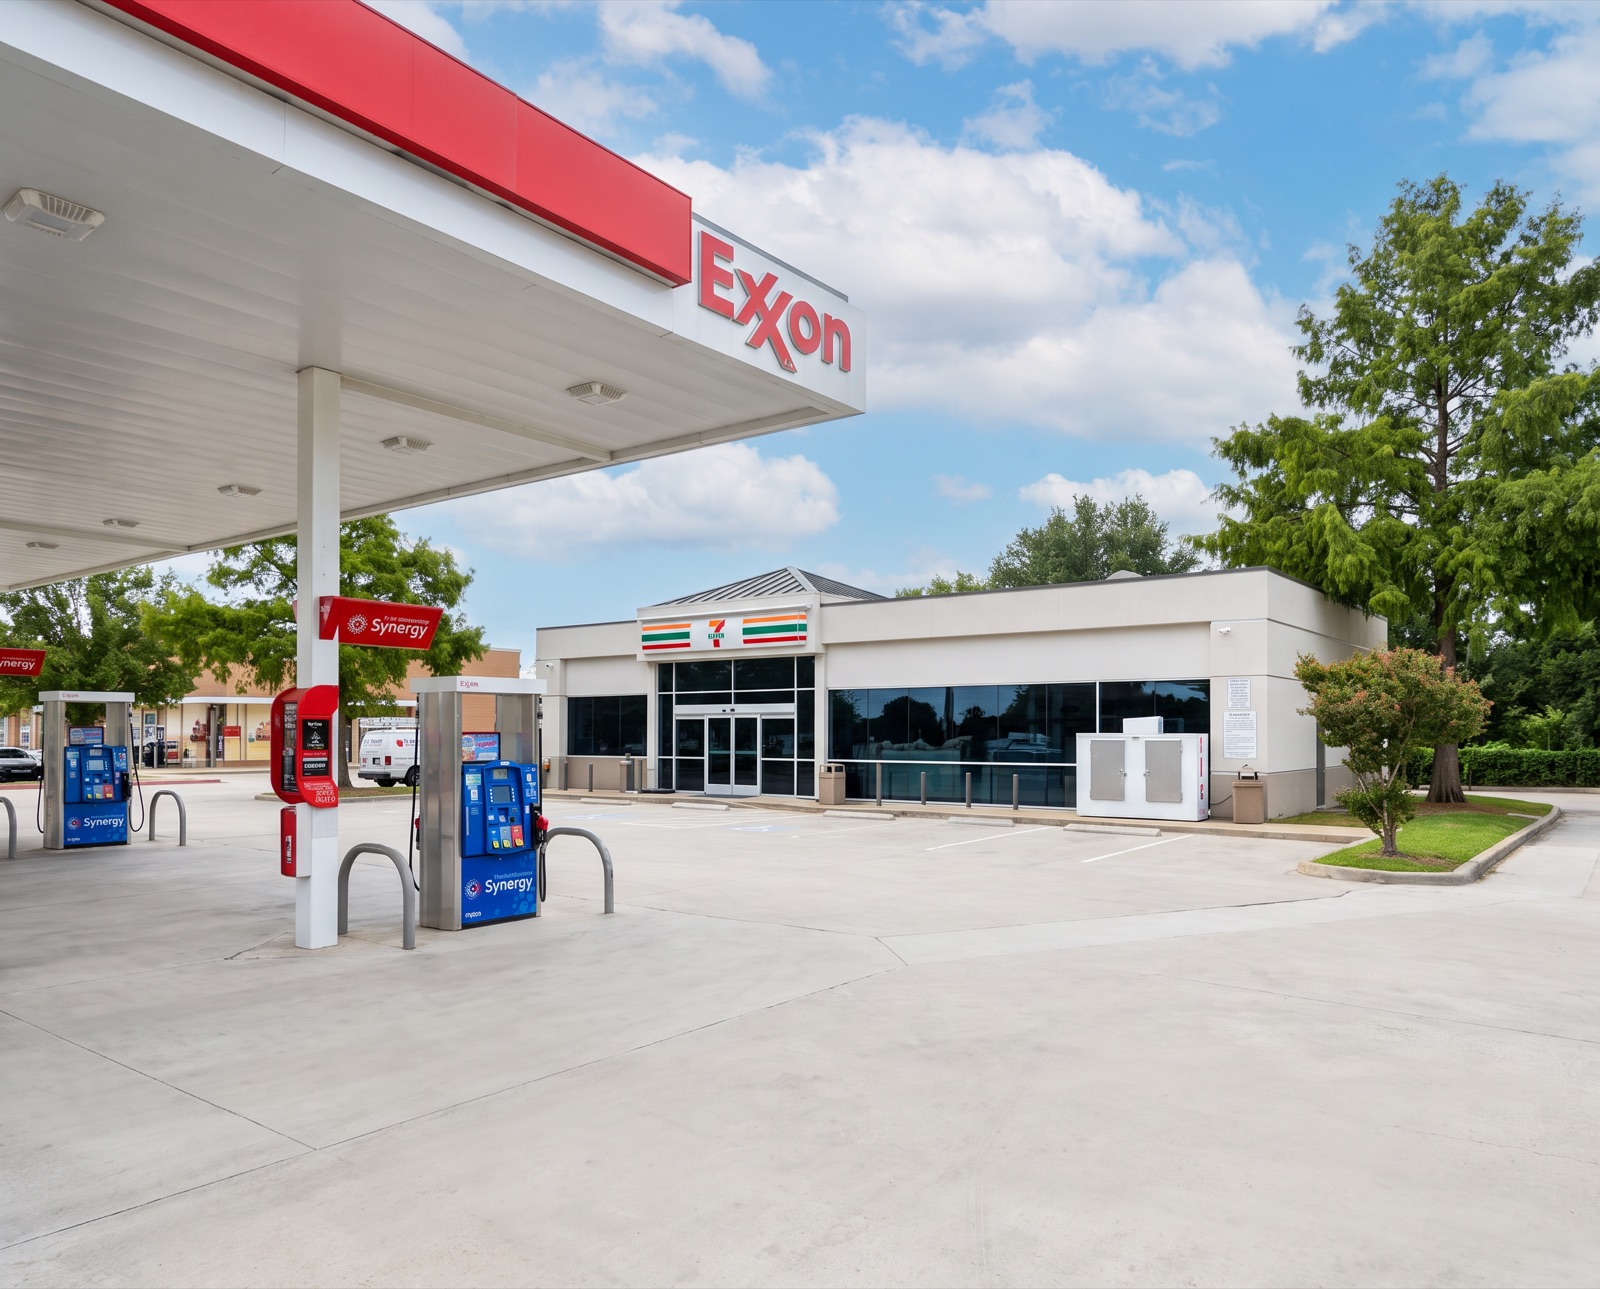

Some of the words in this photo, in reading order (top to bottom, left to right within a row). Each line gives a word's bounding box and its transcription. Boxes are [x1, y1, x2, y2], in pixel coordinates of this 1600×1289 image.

[698, 230, 851, 373] Exxon
[371, 618, 429, 639] Synergy
[708, 619, 726, 648] 7
[83, 817, 125, 828] Synergy
[485, 877, 533, 896] Synergy
